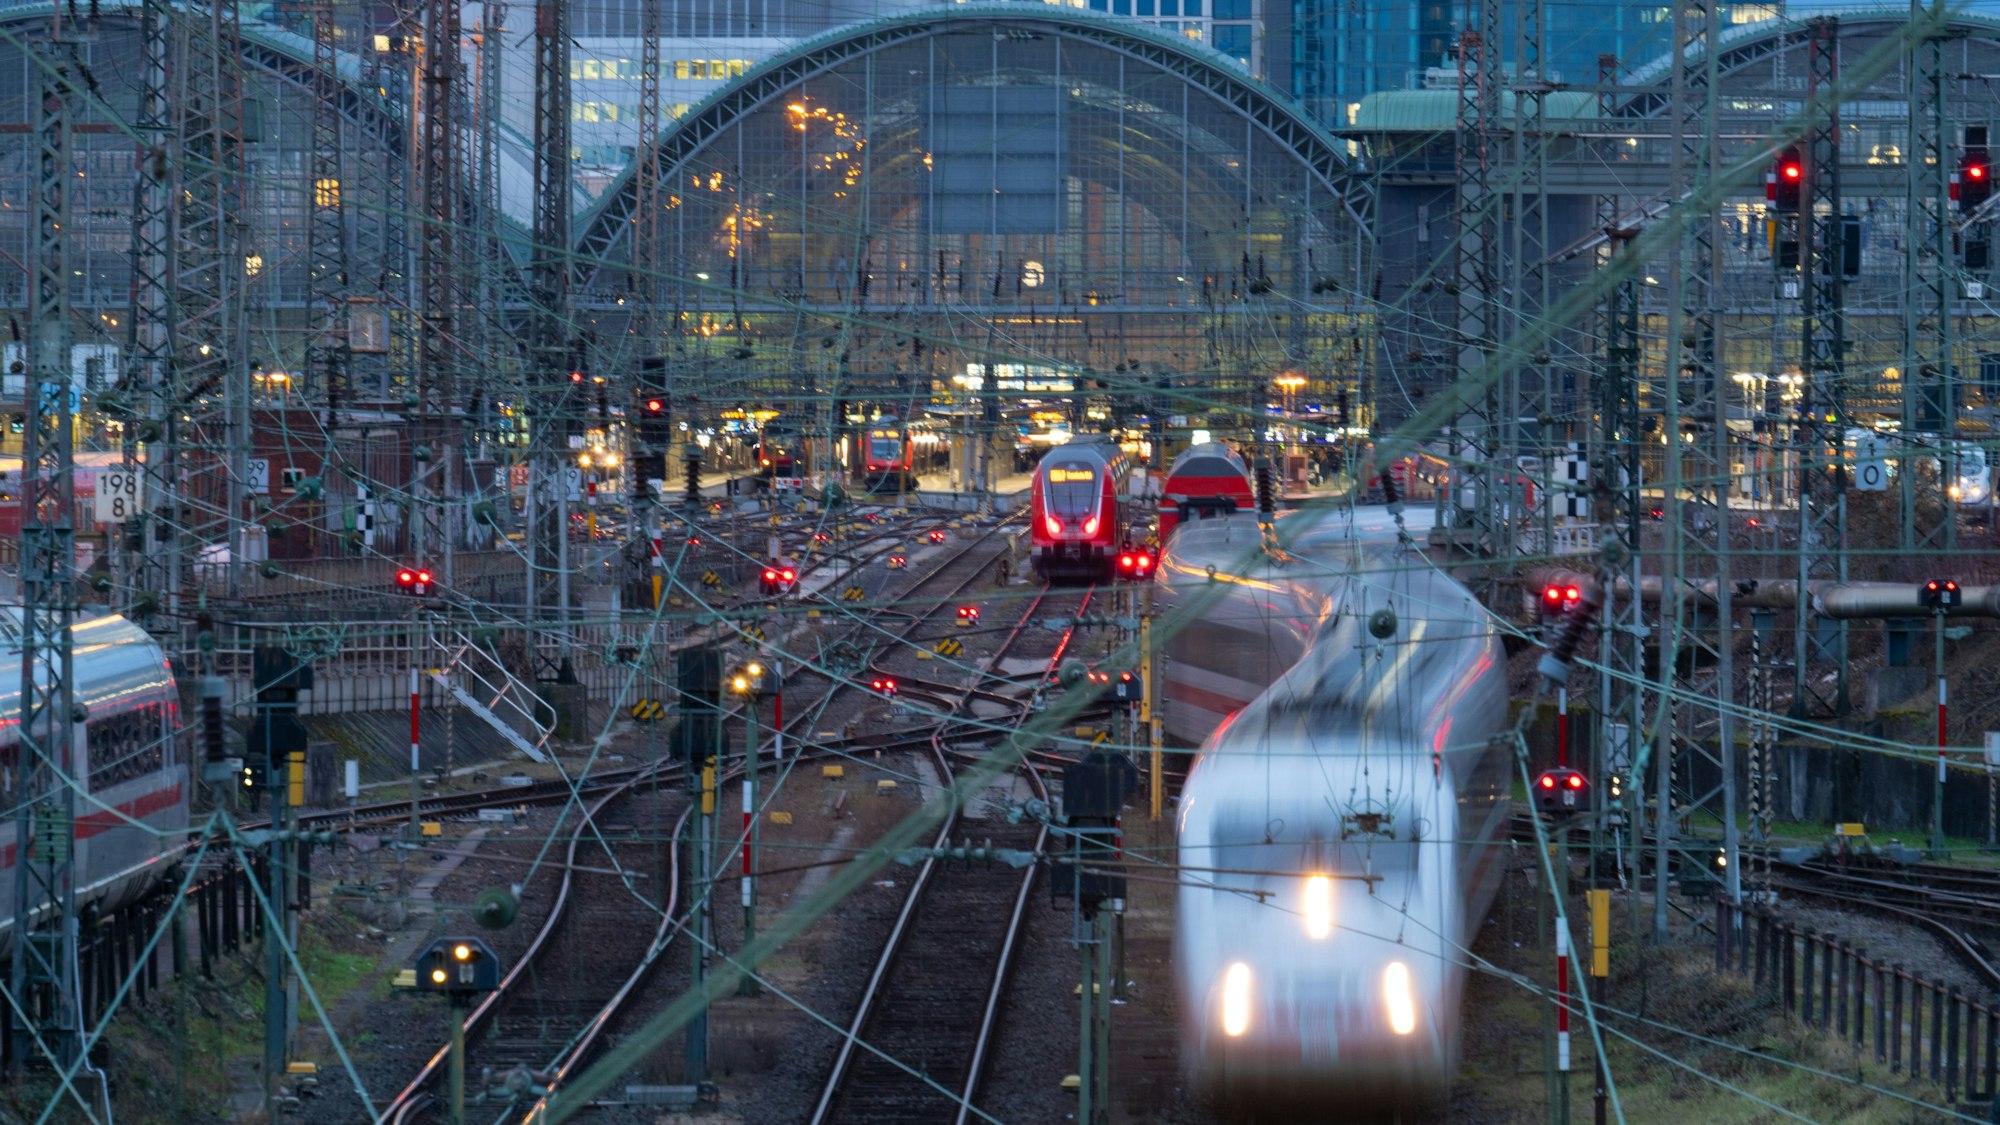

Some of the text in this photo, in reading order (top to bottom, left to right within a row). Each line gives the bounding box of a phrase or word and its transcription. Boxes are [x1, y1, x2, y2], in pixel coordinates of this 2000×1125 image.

[101, 473, 136, 495] 198
[1863, 465, 1879, 485] 0
[112, 497, 124, 517] 8
